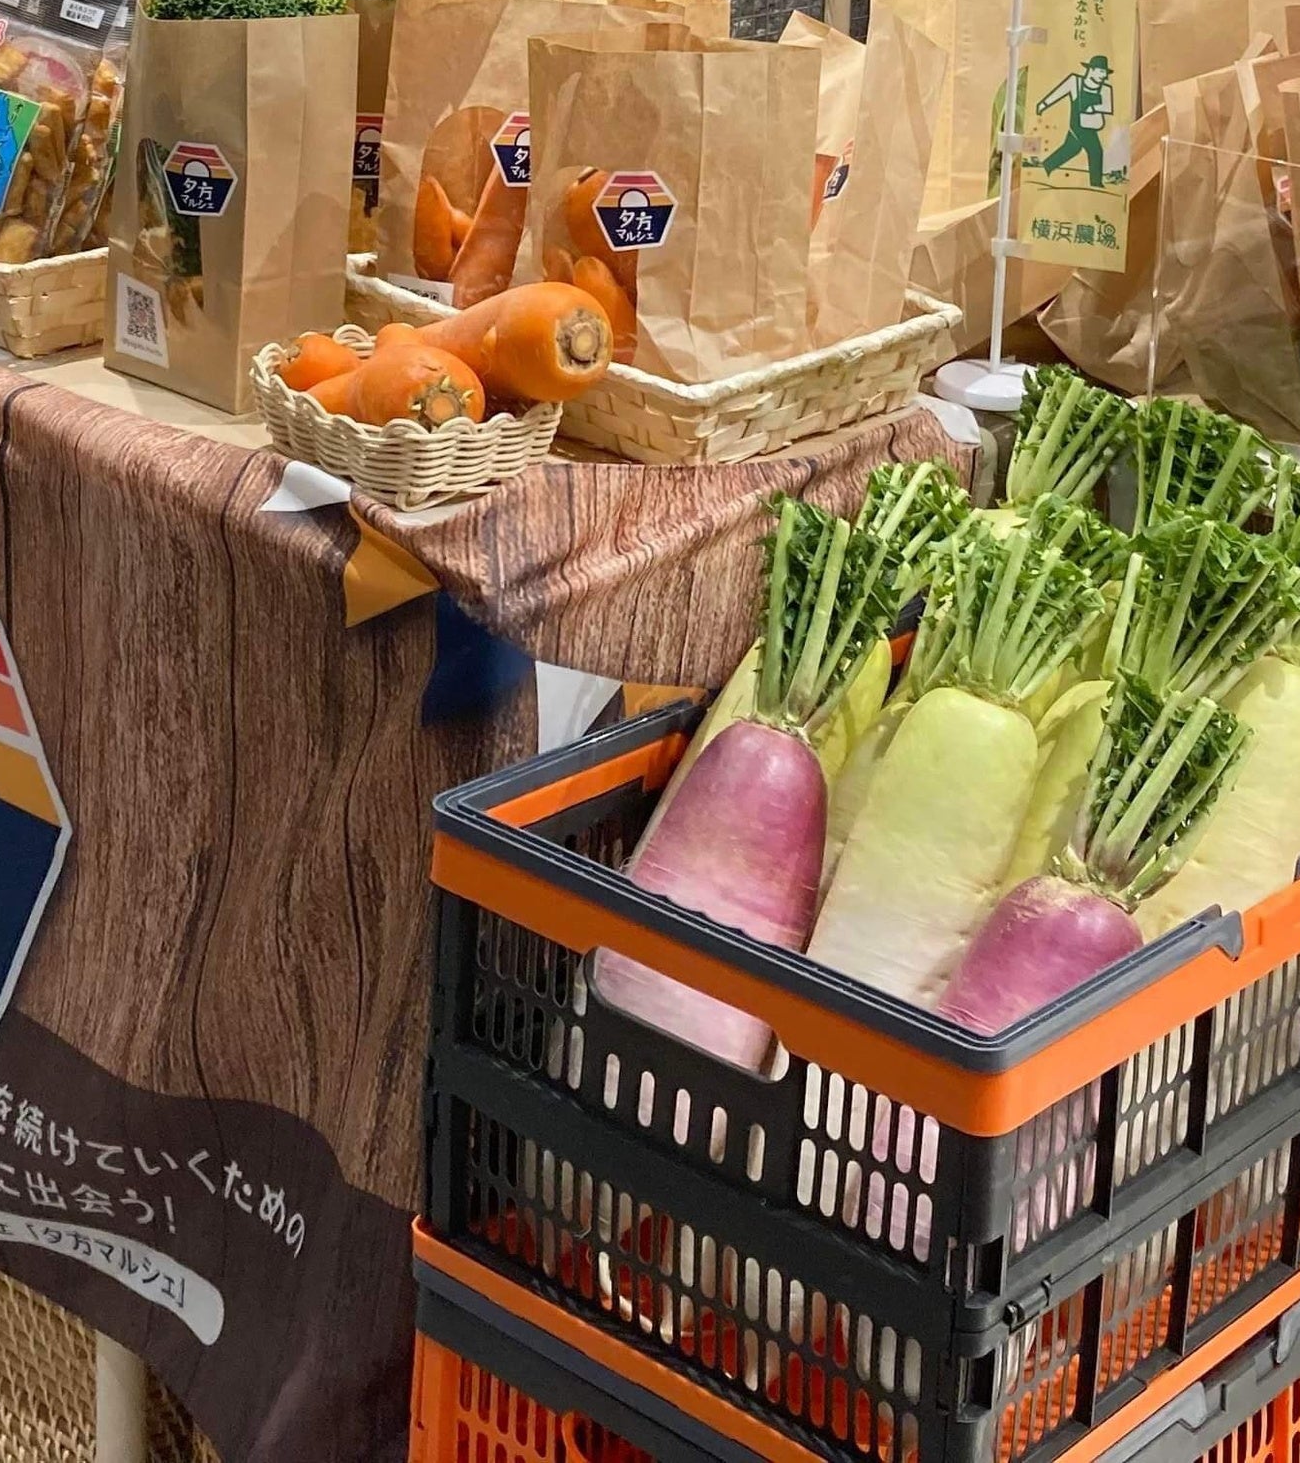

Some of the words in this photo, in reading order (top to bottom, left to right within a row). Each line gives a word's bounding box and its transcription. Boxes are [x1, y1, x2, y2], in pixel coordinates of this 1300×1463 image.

[180, 192, 216, 211] マルシェ
[183, 177, 214, 202] 夕方
[618, 208, 652, 232] 夕方
[615, 226, 656, 243] マルシェ
[1030, 216, 1119, 251] 横浜農場
